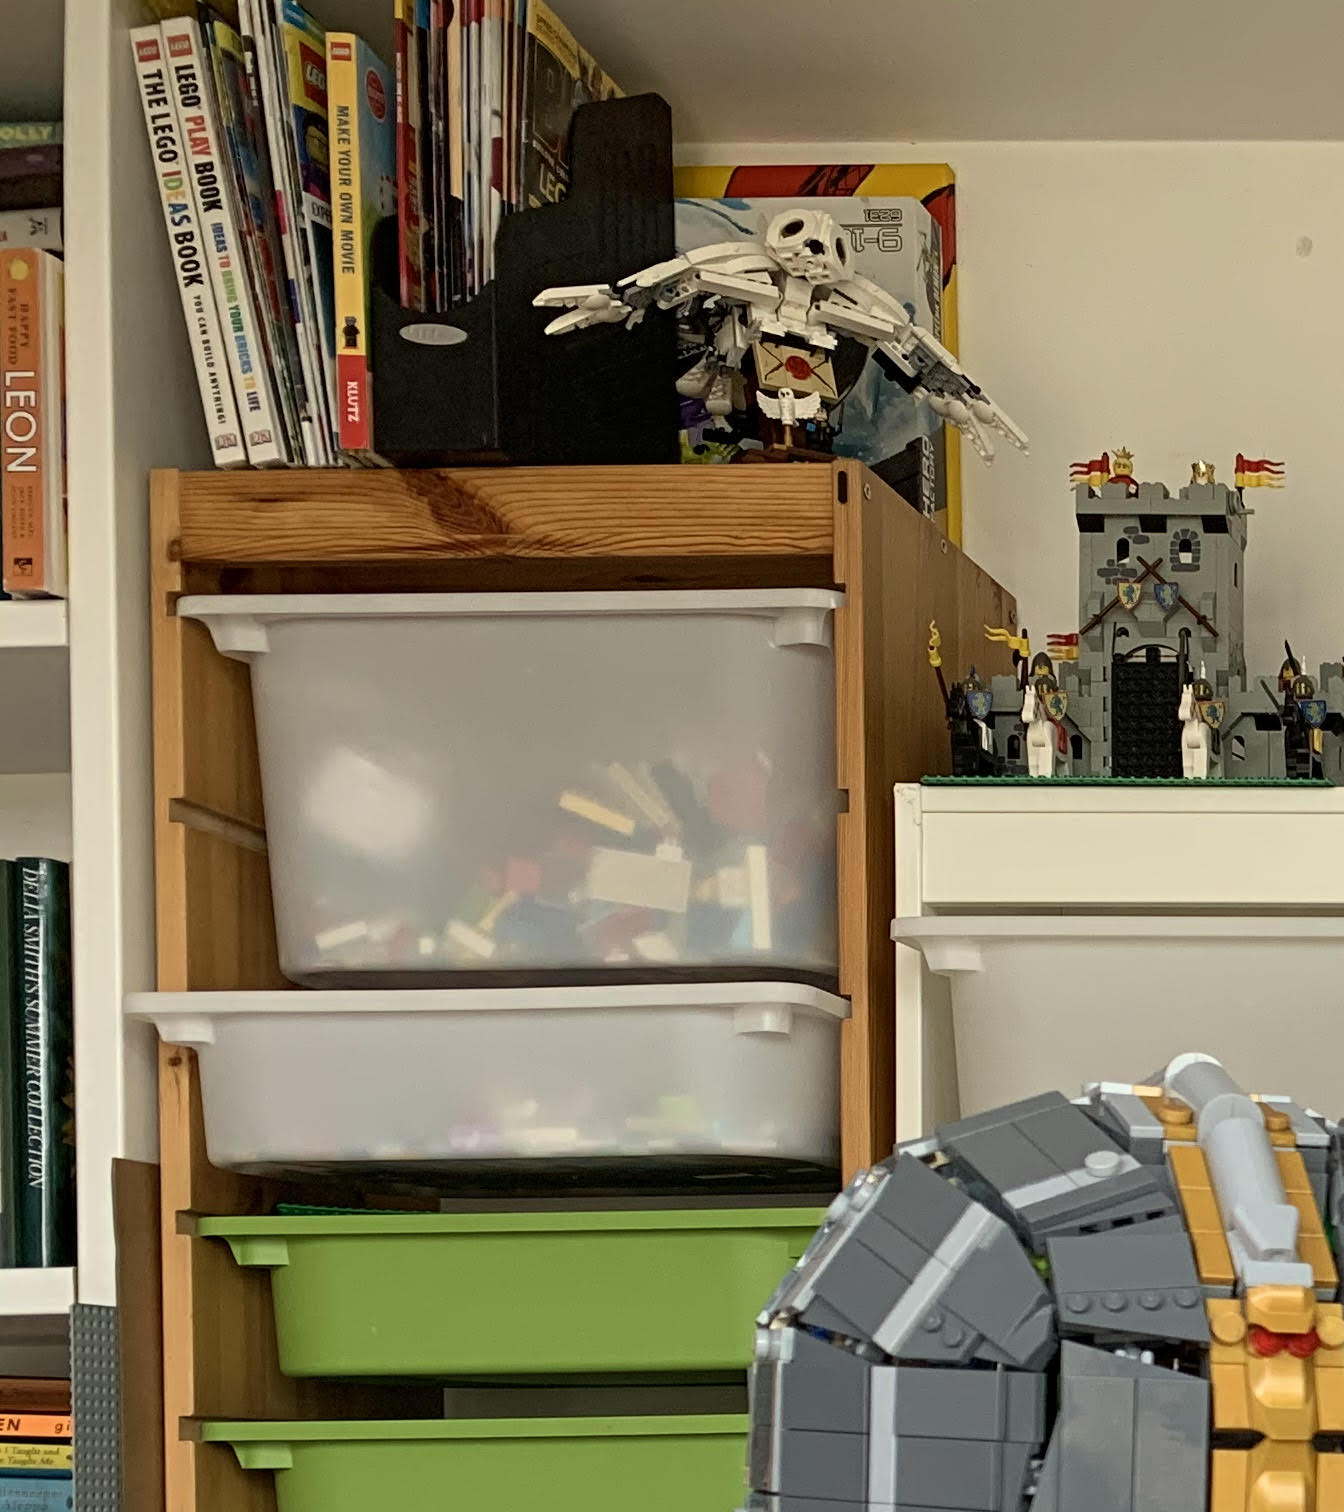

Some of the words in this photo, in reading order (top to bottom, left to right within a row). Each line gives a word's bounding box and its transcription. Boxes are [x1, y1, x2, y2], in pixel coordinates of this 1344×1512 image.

[143, 69, 168, 109] THE
[174, 64, 201, 109] LEGO
[151, 112, 178, 163] LEGO
[185, 115, 212, 156] PLAY
[336, 105, 351, 145] MAKE
[194, 161, 223, 213] BOOK
[338, 150, 353, 187] YOUR
[162, 170, 192, 227] IDEAS
[340, 193, 354, 224] OWN
[863, 208, 903, 222] 6231
[211, 222, 228, 252] IDEAS
[341, 230, 355, 274] MOVIE
[174, 231, 204, 288] BOOK
[218, 255, 231, 268] TO
[193, 295, 204, 314] YOU
[221, 270, 238, 303] BRING
[20, 303, 30, 348] HAPPY
[198, 317, 208, 335] CAN
[228, 304, 244, 333] YOUR
[8, 326, 18, 365] FOOD
[202, 339, 215, 368] BUILD
[234, 334, 253, 375] BRICKS
[208, 372, 227, 424] ANYTHING!
[243, 375, 257, 390] TO
[246, 391, 261, 412] LIFE
[347, 381, 360, 423] KLUTZ
[5, 371, 37, 473] LEON
[922, 434, 930, 520] HERO
[22, 868, 40, 920] DELIA
[24, 997, 42, 1077] SUMMER
[26, 1079, 45, 1192] COLLECTION
